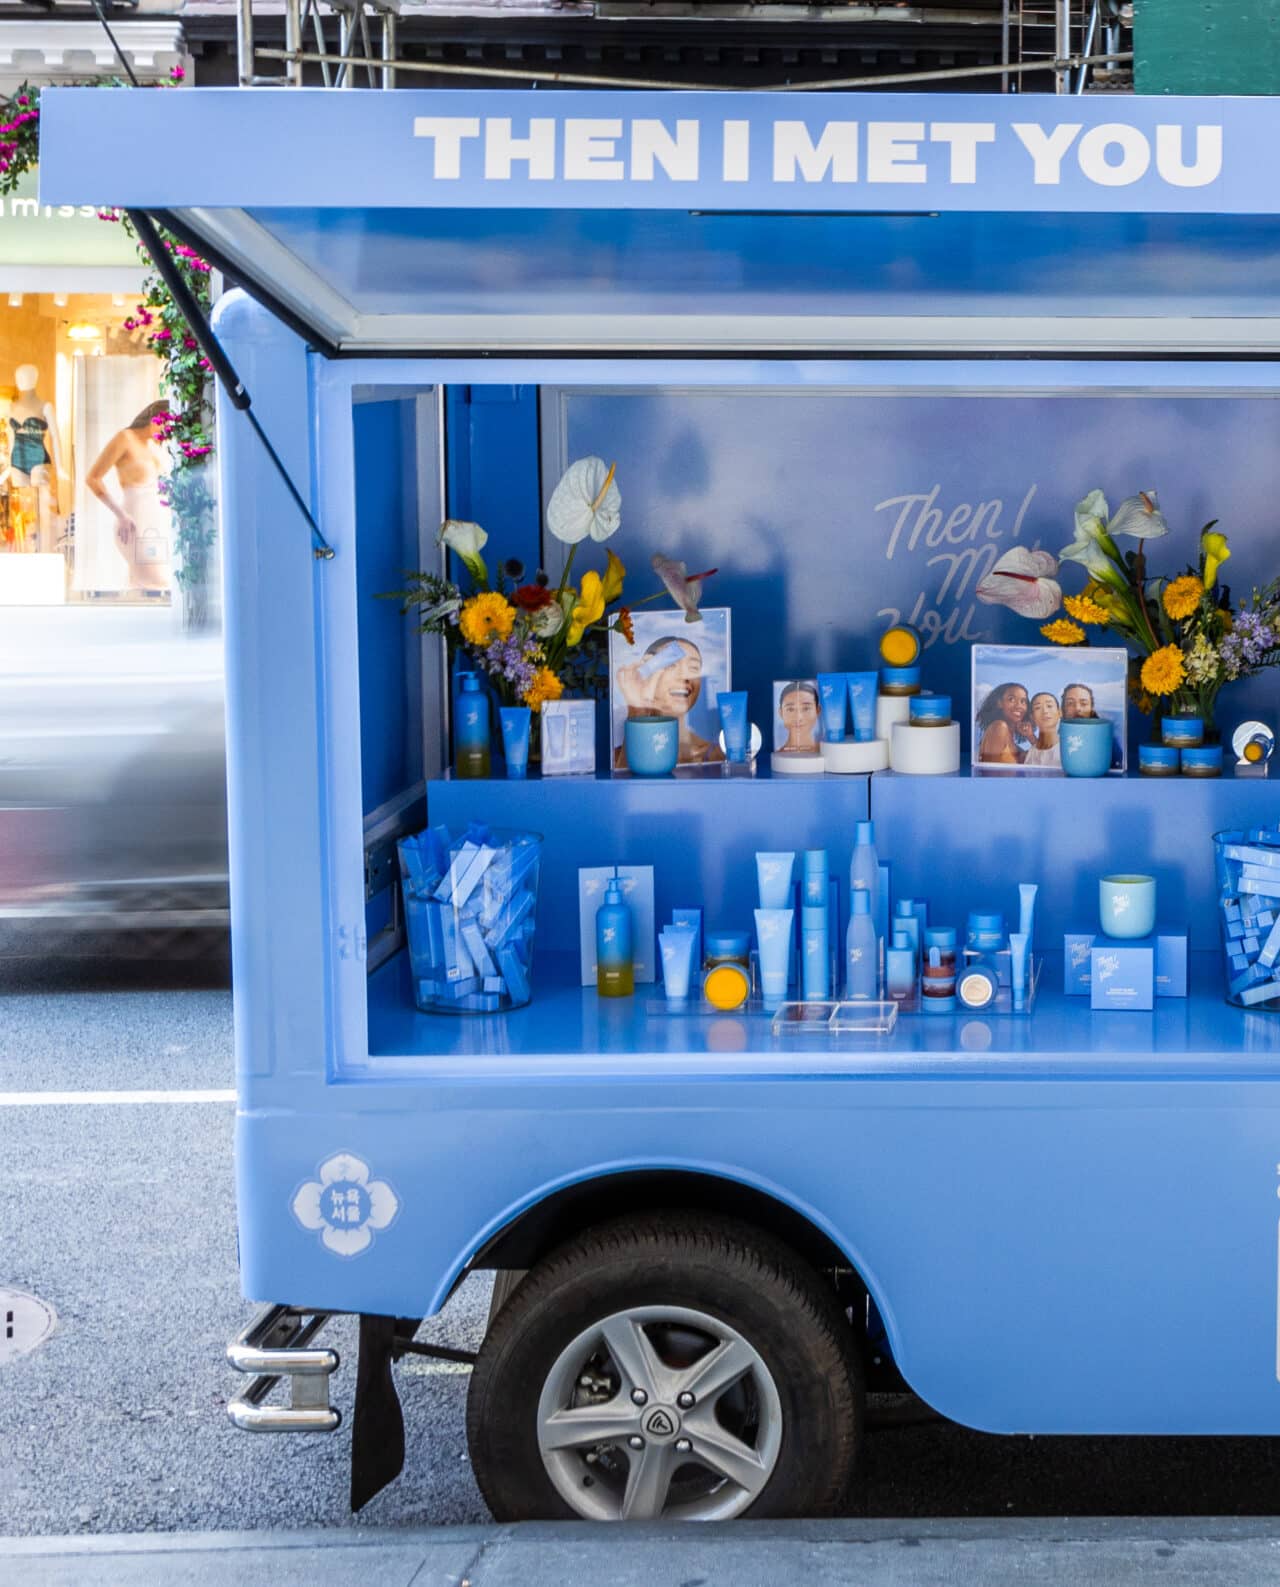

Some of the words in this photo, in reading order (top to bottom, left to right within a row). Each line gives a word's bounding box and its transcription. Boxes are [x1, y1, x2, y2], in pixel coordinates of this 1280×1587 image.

[414, 117, 699, 181] THEN
[723, 120, 749, 182] I
[773, 121, 995, 184] MET
[1012, 123, 1223, 187] YOU
[874, 483, 1003, 560] Then
[1012, 483, 1038, 538] I
